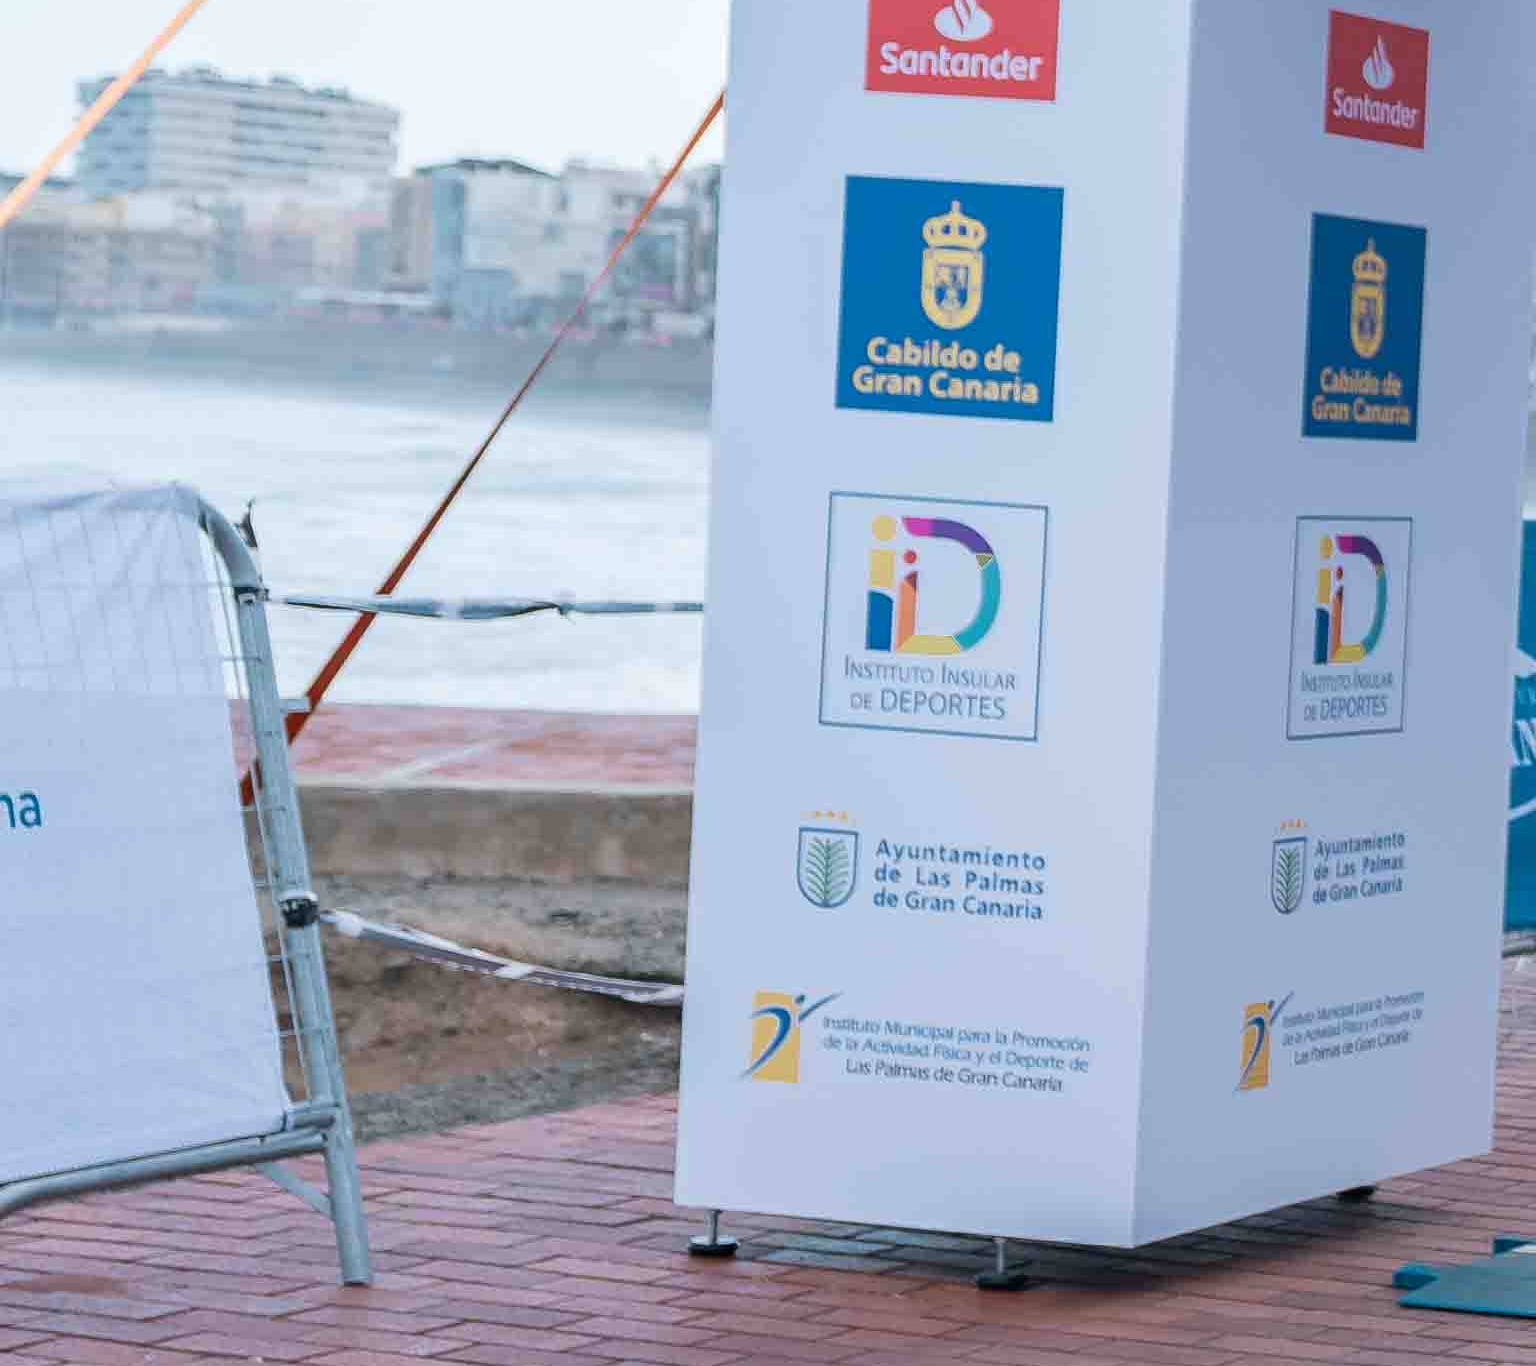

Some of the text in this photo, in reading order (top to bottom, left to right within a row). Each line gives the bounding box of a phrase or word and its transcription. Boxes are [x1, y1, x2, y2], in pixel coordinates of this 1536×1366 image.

[879, 42, 1044, 82] Santander
[1332, 87, 1420, 130] Santander
[866, 337, 1021, 373] Cabildo de
[853, 366, 1040, 404] Gran Canaria
[843, 655, 1016, 691] INSTITUTO INSULAR
[879, 689, 1007, 720] DEPORTES
[876, 838, 1046, 870] Ayuntamiento
[874, 863, 1044, 896] de Las Palmas
[873, 889, 1043, 921] de Gran Canaria
